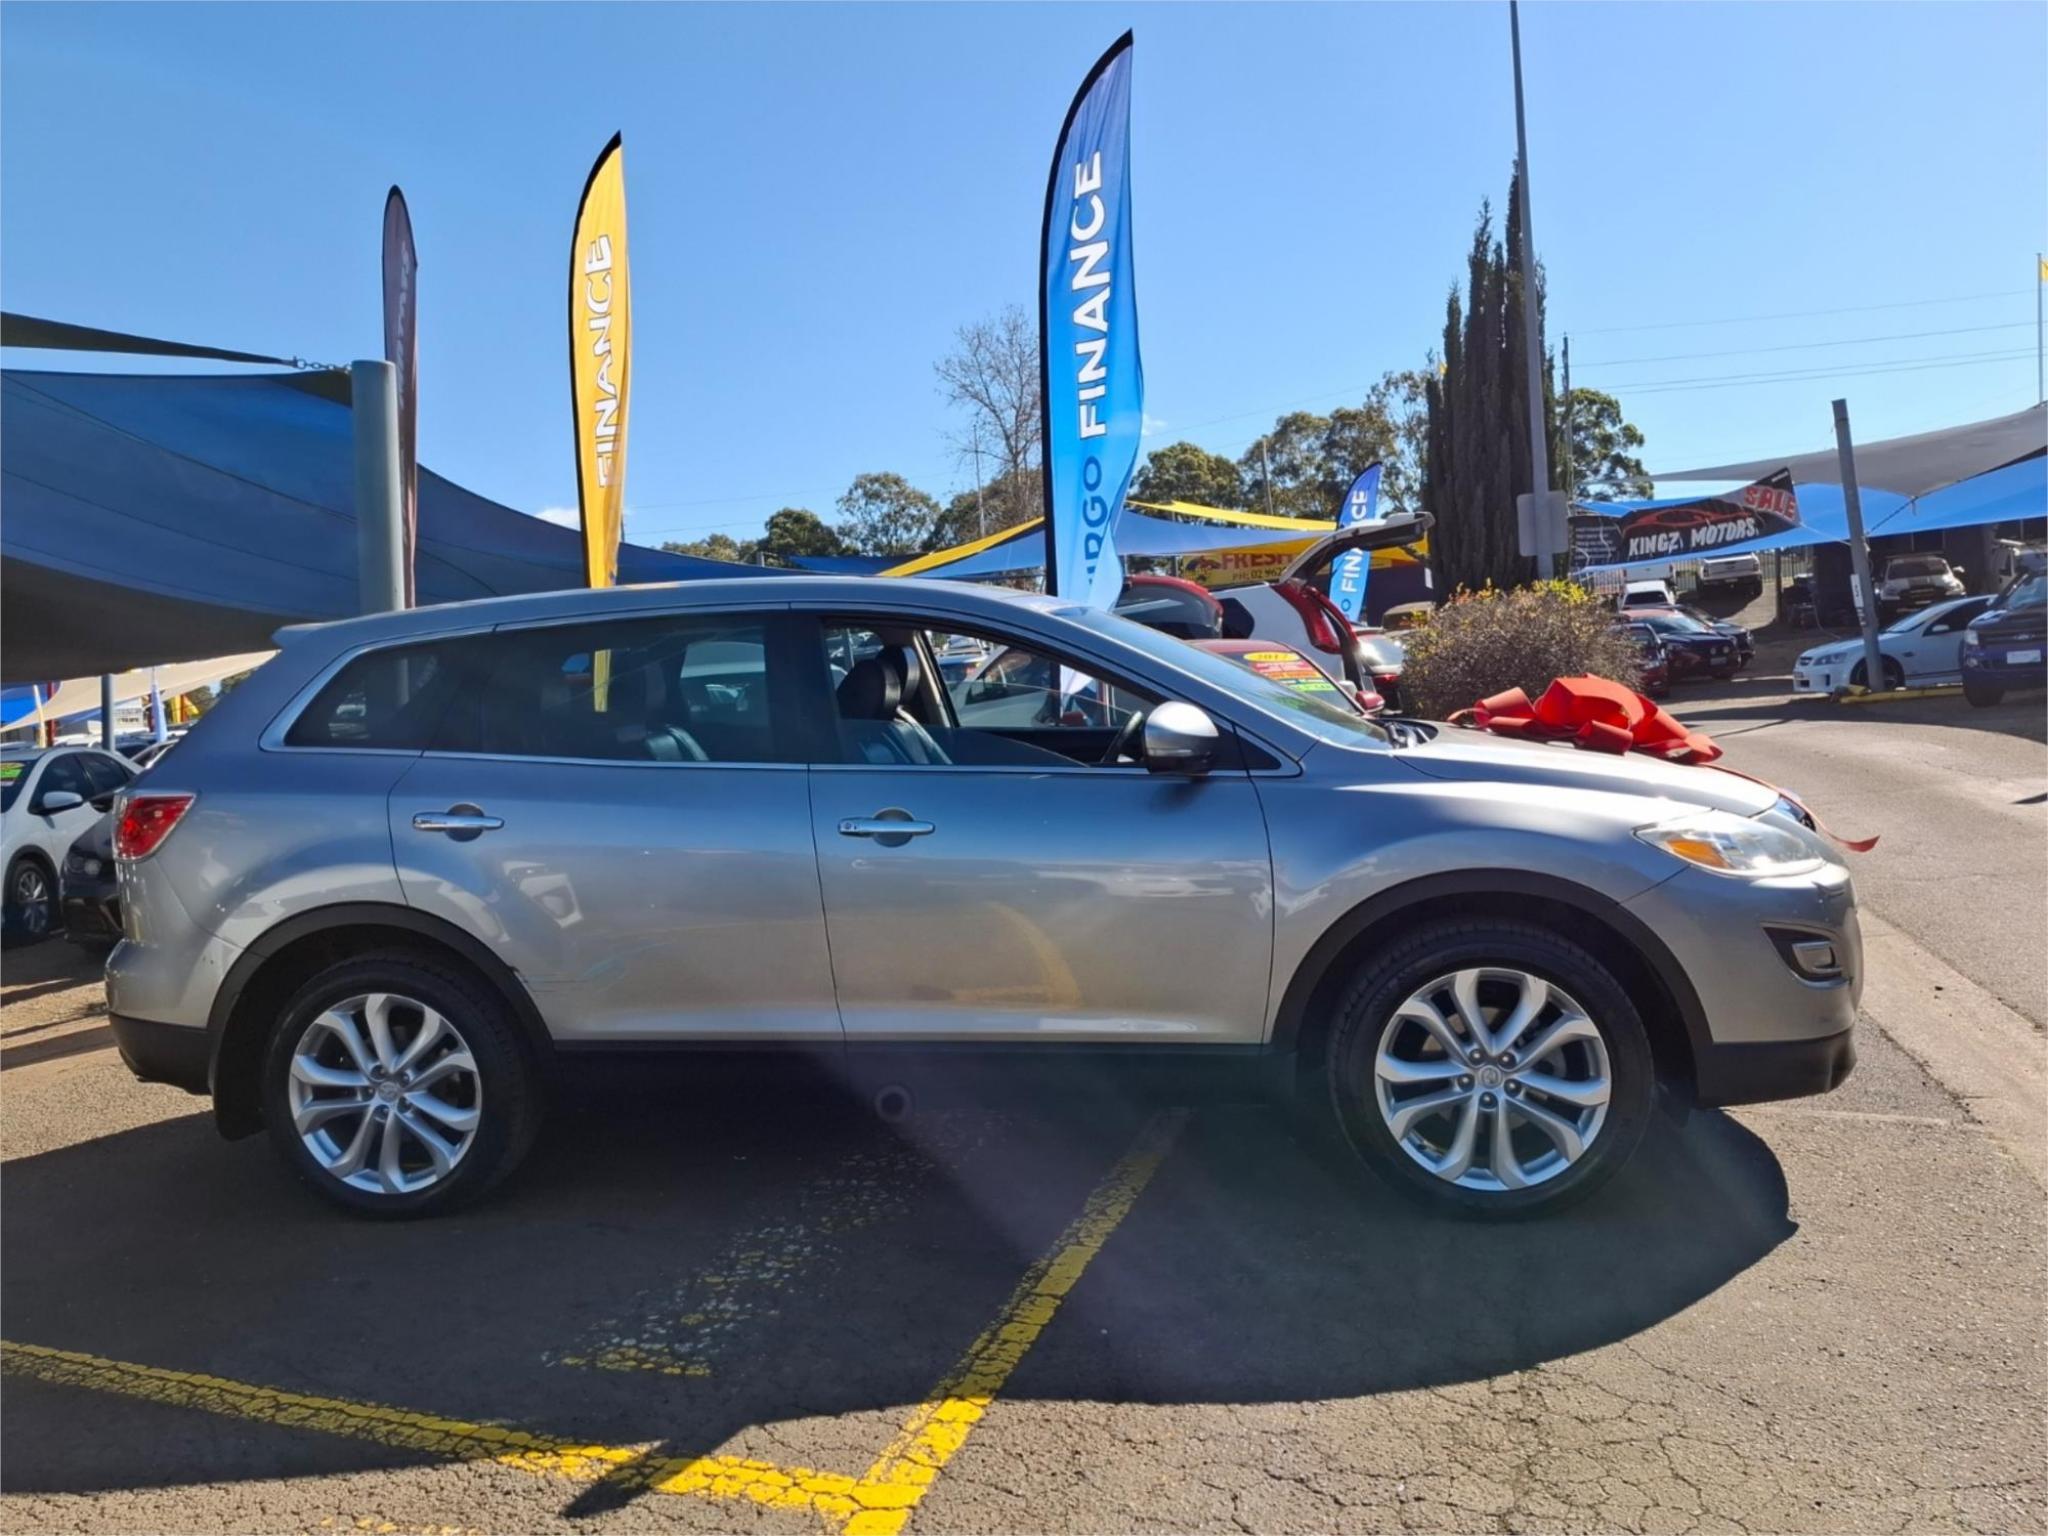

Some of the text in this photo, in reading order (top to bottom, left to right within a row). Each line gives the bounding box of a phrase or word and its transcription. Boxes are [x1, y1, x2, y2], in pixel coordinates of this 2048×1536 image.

[1070, 151, 1111, 438] FINANCE
[585, 234, 620, 488] FINANCE
[1341, 490, 1368, 593] FINCE
[1628, 532, 1681, 557] KINGZ
[1690, 517, 1756, 548] MOTORS
[1744, 486, 1797, 521] SALE
